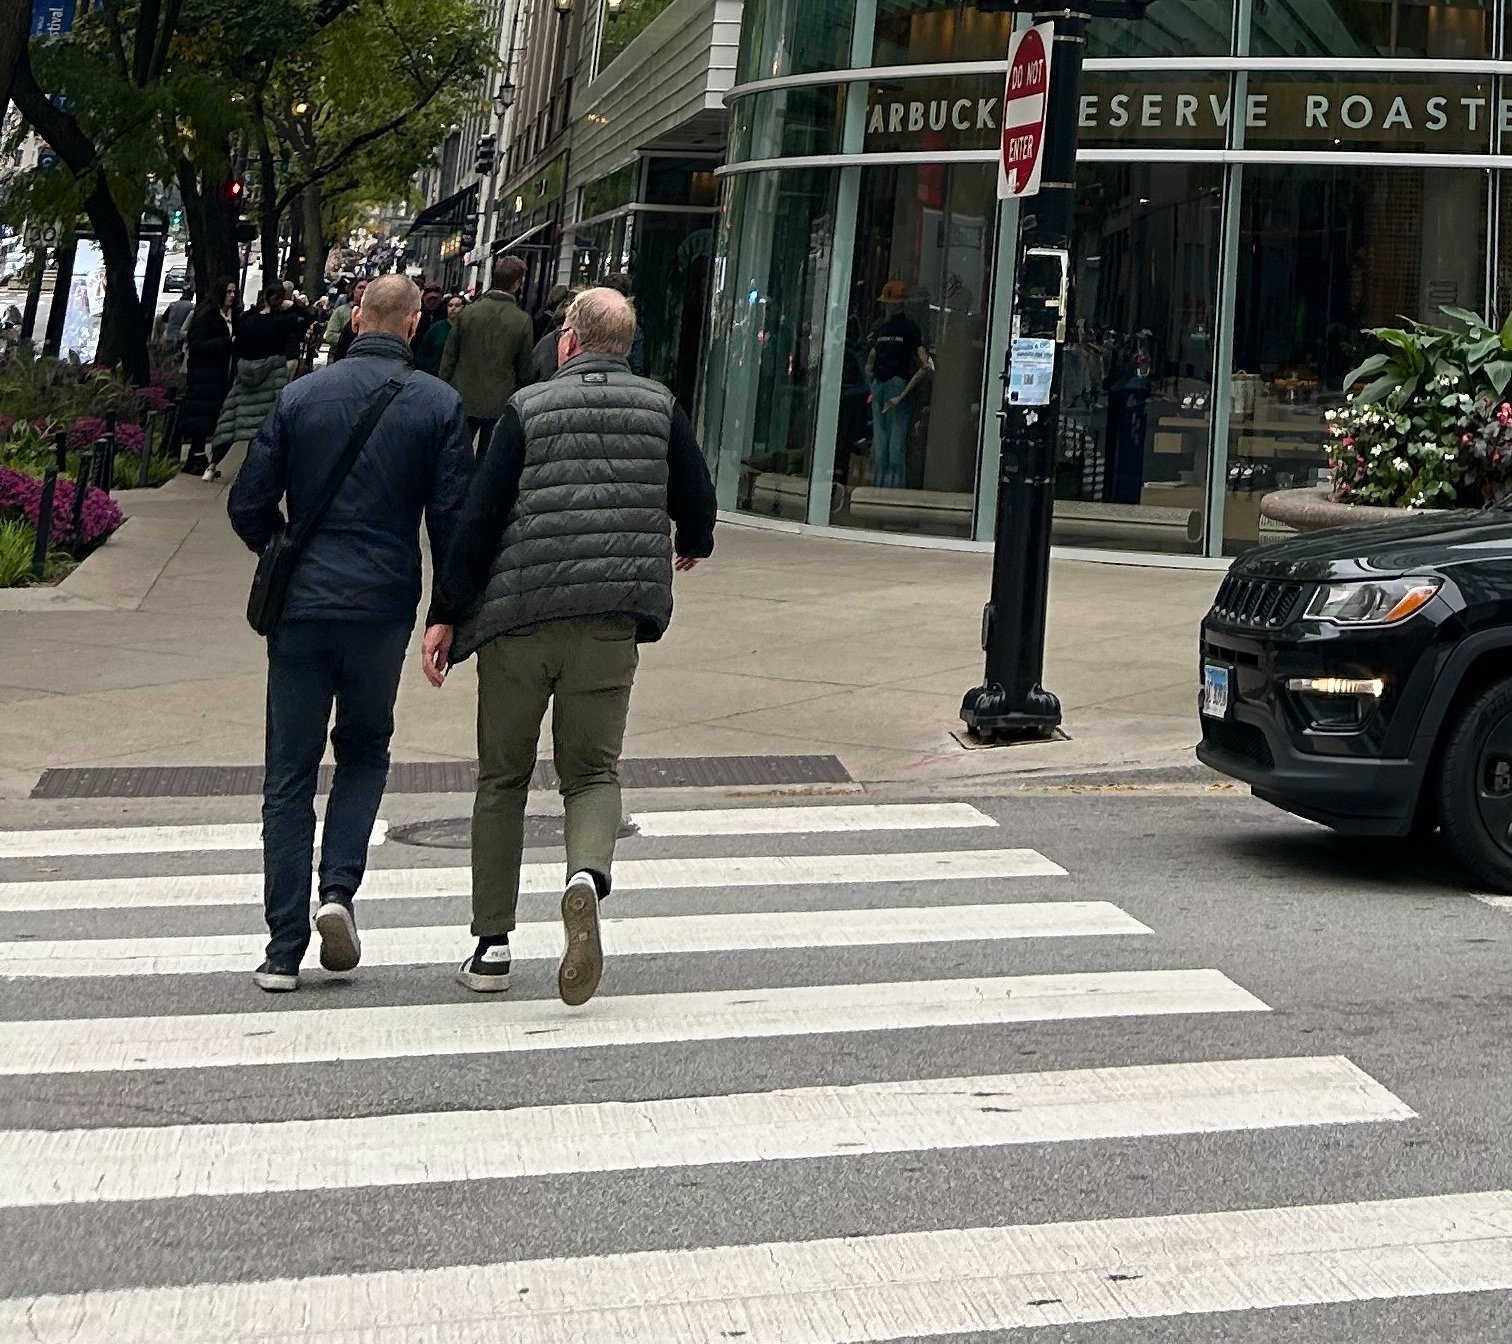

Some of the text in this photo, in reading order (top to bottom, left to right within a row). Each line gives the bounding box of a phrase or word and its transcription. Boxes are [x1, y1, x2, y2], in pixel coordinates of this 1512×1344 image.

[1011, 58, 1044, 90] DO NOT
[867, 96, 1000, 134] ARBUCK
[1077, 93, 1269, 128] ESERVE
[1008, 134, 1034, 163] ENTER
